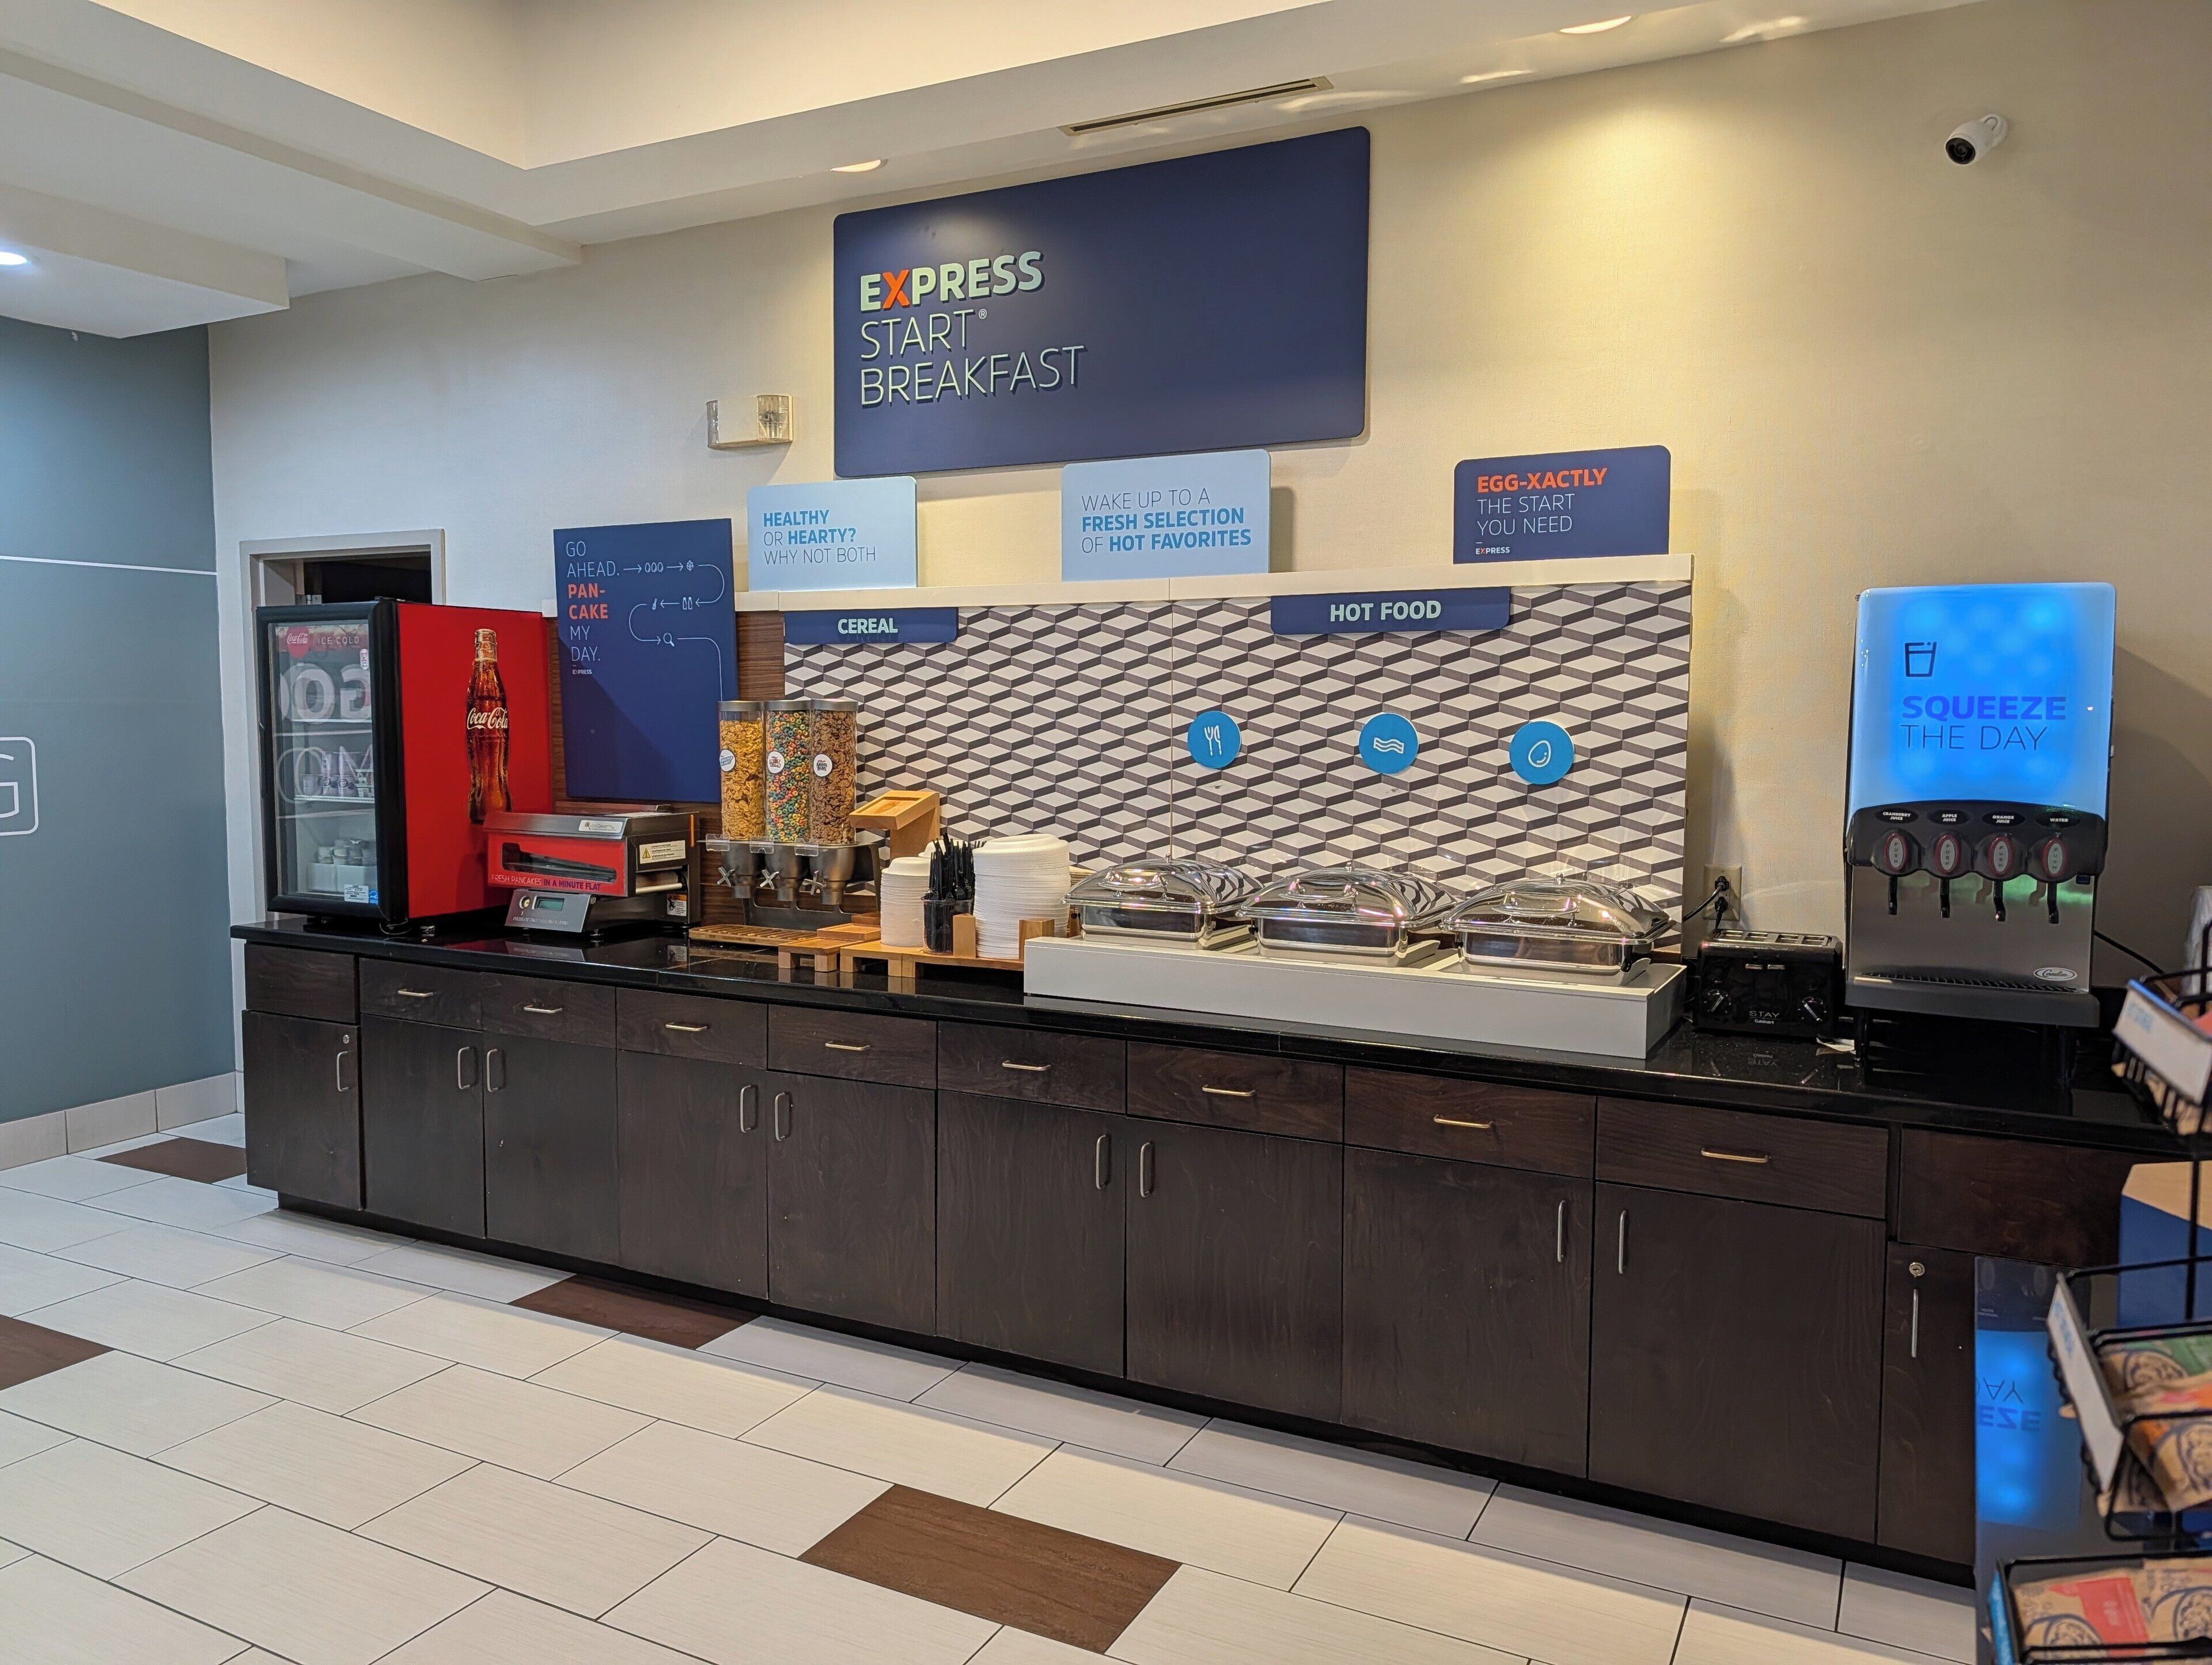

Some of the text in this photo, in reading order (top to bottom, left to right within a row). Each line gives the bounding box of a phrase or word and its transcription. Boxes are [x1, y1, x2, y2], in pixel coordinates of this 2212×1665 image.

[861, 251, 1043, 312] EXPRESS
[861, 345, 1085, 405] BREAKFAST
[1477, 467, 1608, 493] EGG-XACTLY
[1082, 487, 1210, 511] WAKE UP TO A
[1477, 493, 1575, 515] THE START
[763, 509, 830, 527] HEALTHY
[1082, 507, 1244, 532] FRESH SELECTION
[1477, 515, 1572, 536] YOU NEED
[764, 528, 856, 546] OR HEARTY?
[1082, 529, 1252, 553] OF HOT FAVORITES
[566, 541, 586, 557] GO
[764, 547, 876, 564] WHY NOT BOTH
[1475, 546, 1510, 555] EXPRESS
[567, 561, 620, 578] AHEAD.
[567, 583, 606, 599] PAN-
[569, 603, 608, 620] CAKE
[1330, 600, 1442, 622] HOT FOOD
[570, 625, 590, 640] MY
[837, 617, 898, 635] CEREAL
[317, 636, 359, 645] ICE COLD
[571, 646, 600, 662] DAY.
[1901, 695, 2066, 720] SQUEEZE
[467, 707, 508, 730] Coca-Cola
[1900, 724, 2048, 751] THE DAY
[491, 874, 510, 882] FRESH
[511, 876, 542, 886] PANCAKES
[559, 881, 584, 889] MINUTE
[585, 883, 602, 891] FLAT
